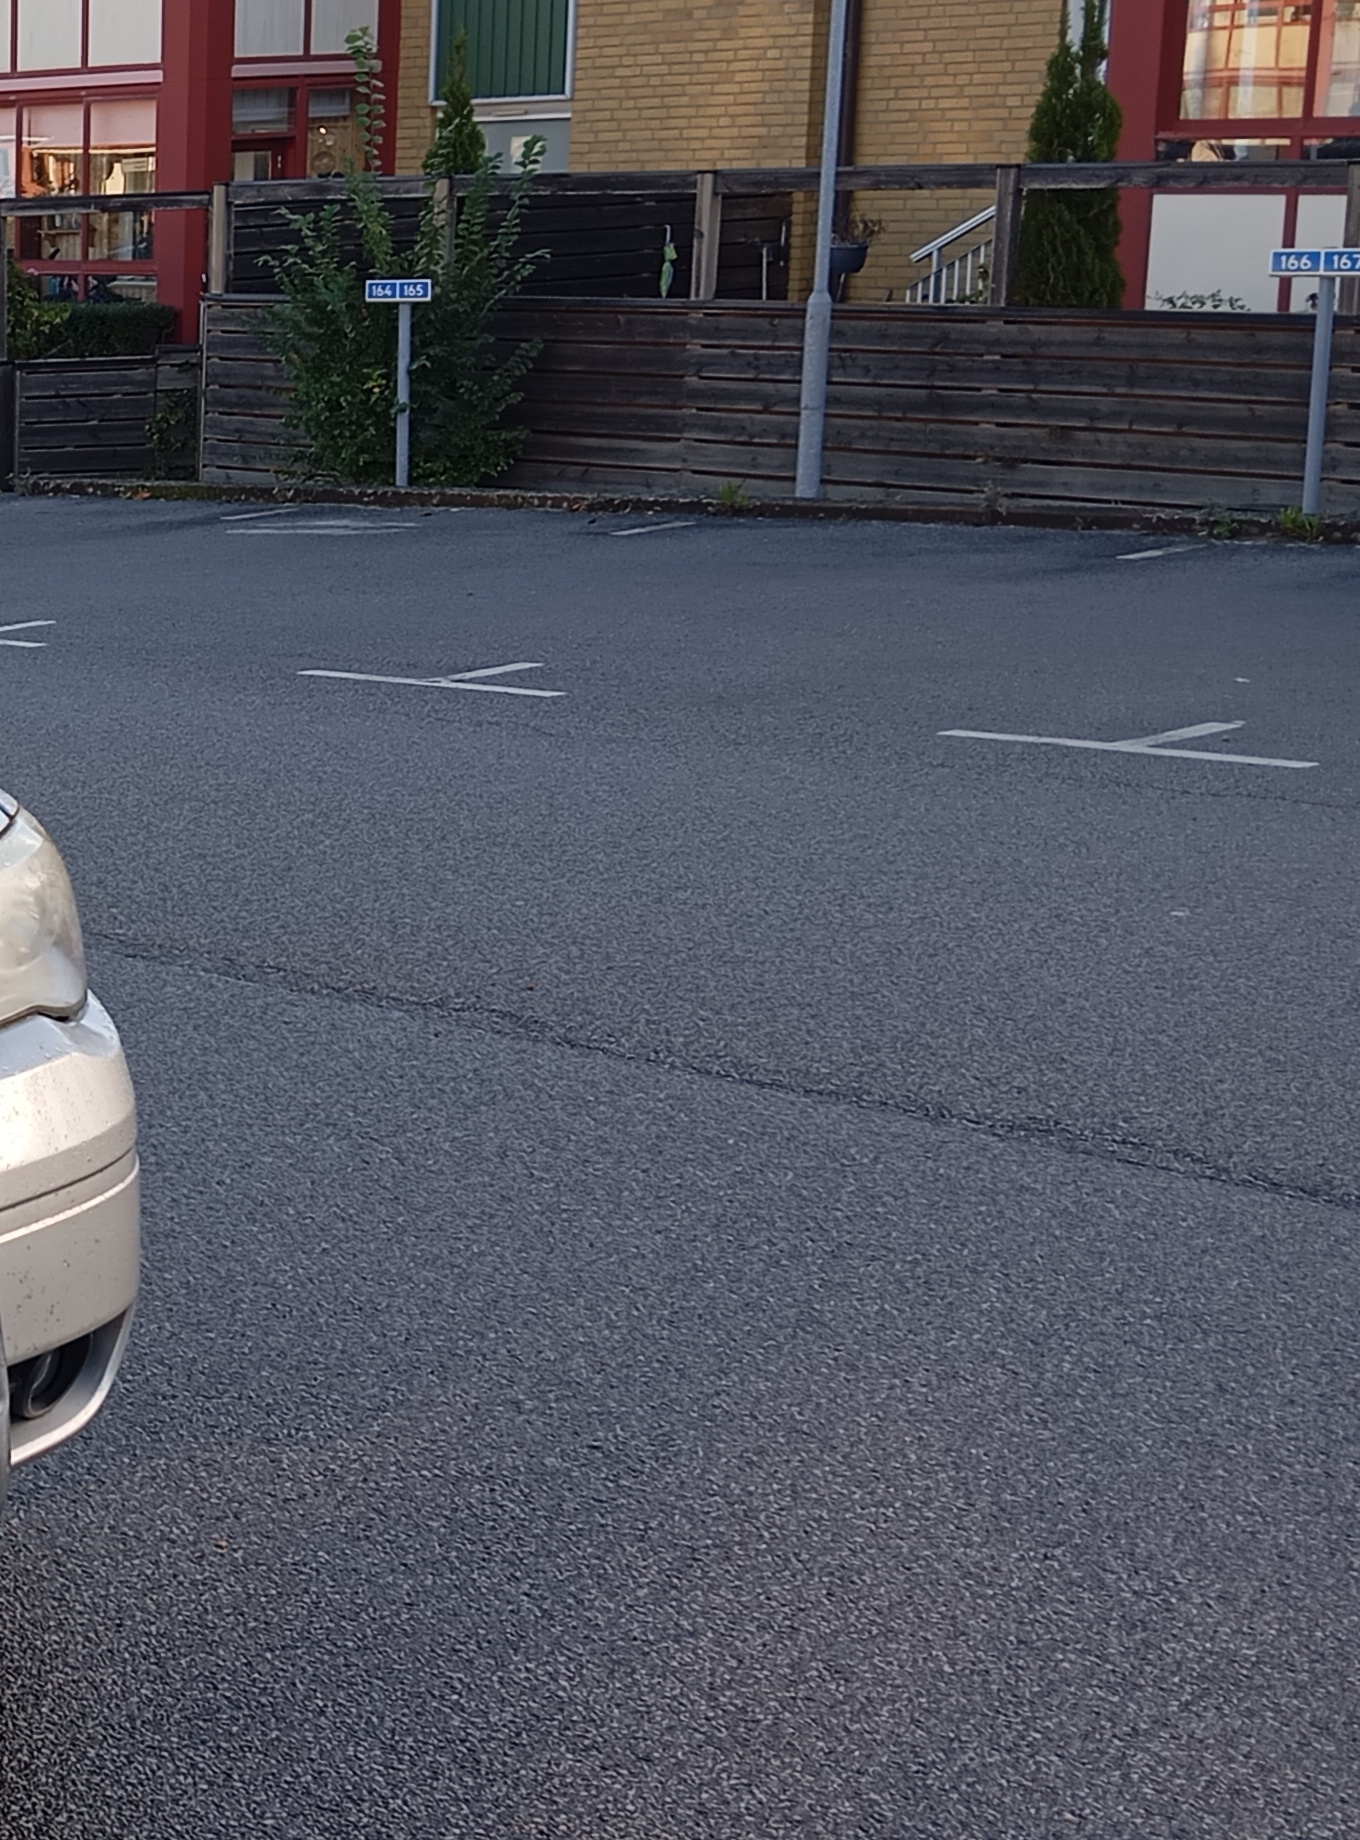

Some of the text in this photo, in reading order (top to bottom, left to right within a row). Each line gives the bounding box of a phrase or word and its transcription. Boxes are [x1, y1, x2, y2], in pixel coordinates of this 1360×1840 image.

[1280, 253, 1360, 270] 166 167
[371, 283, 424, 297] 164 165
